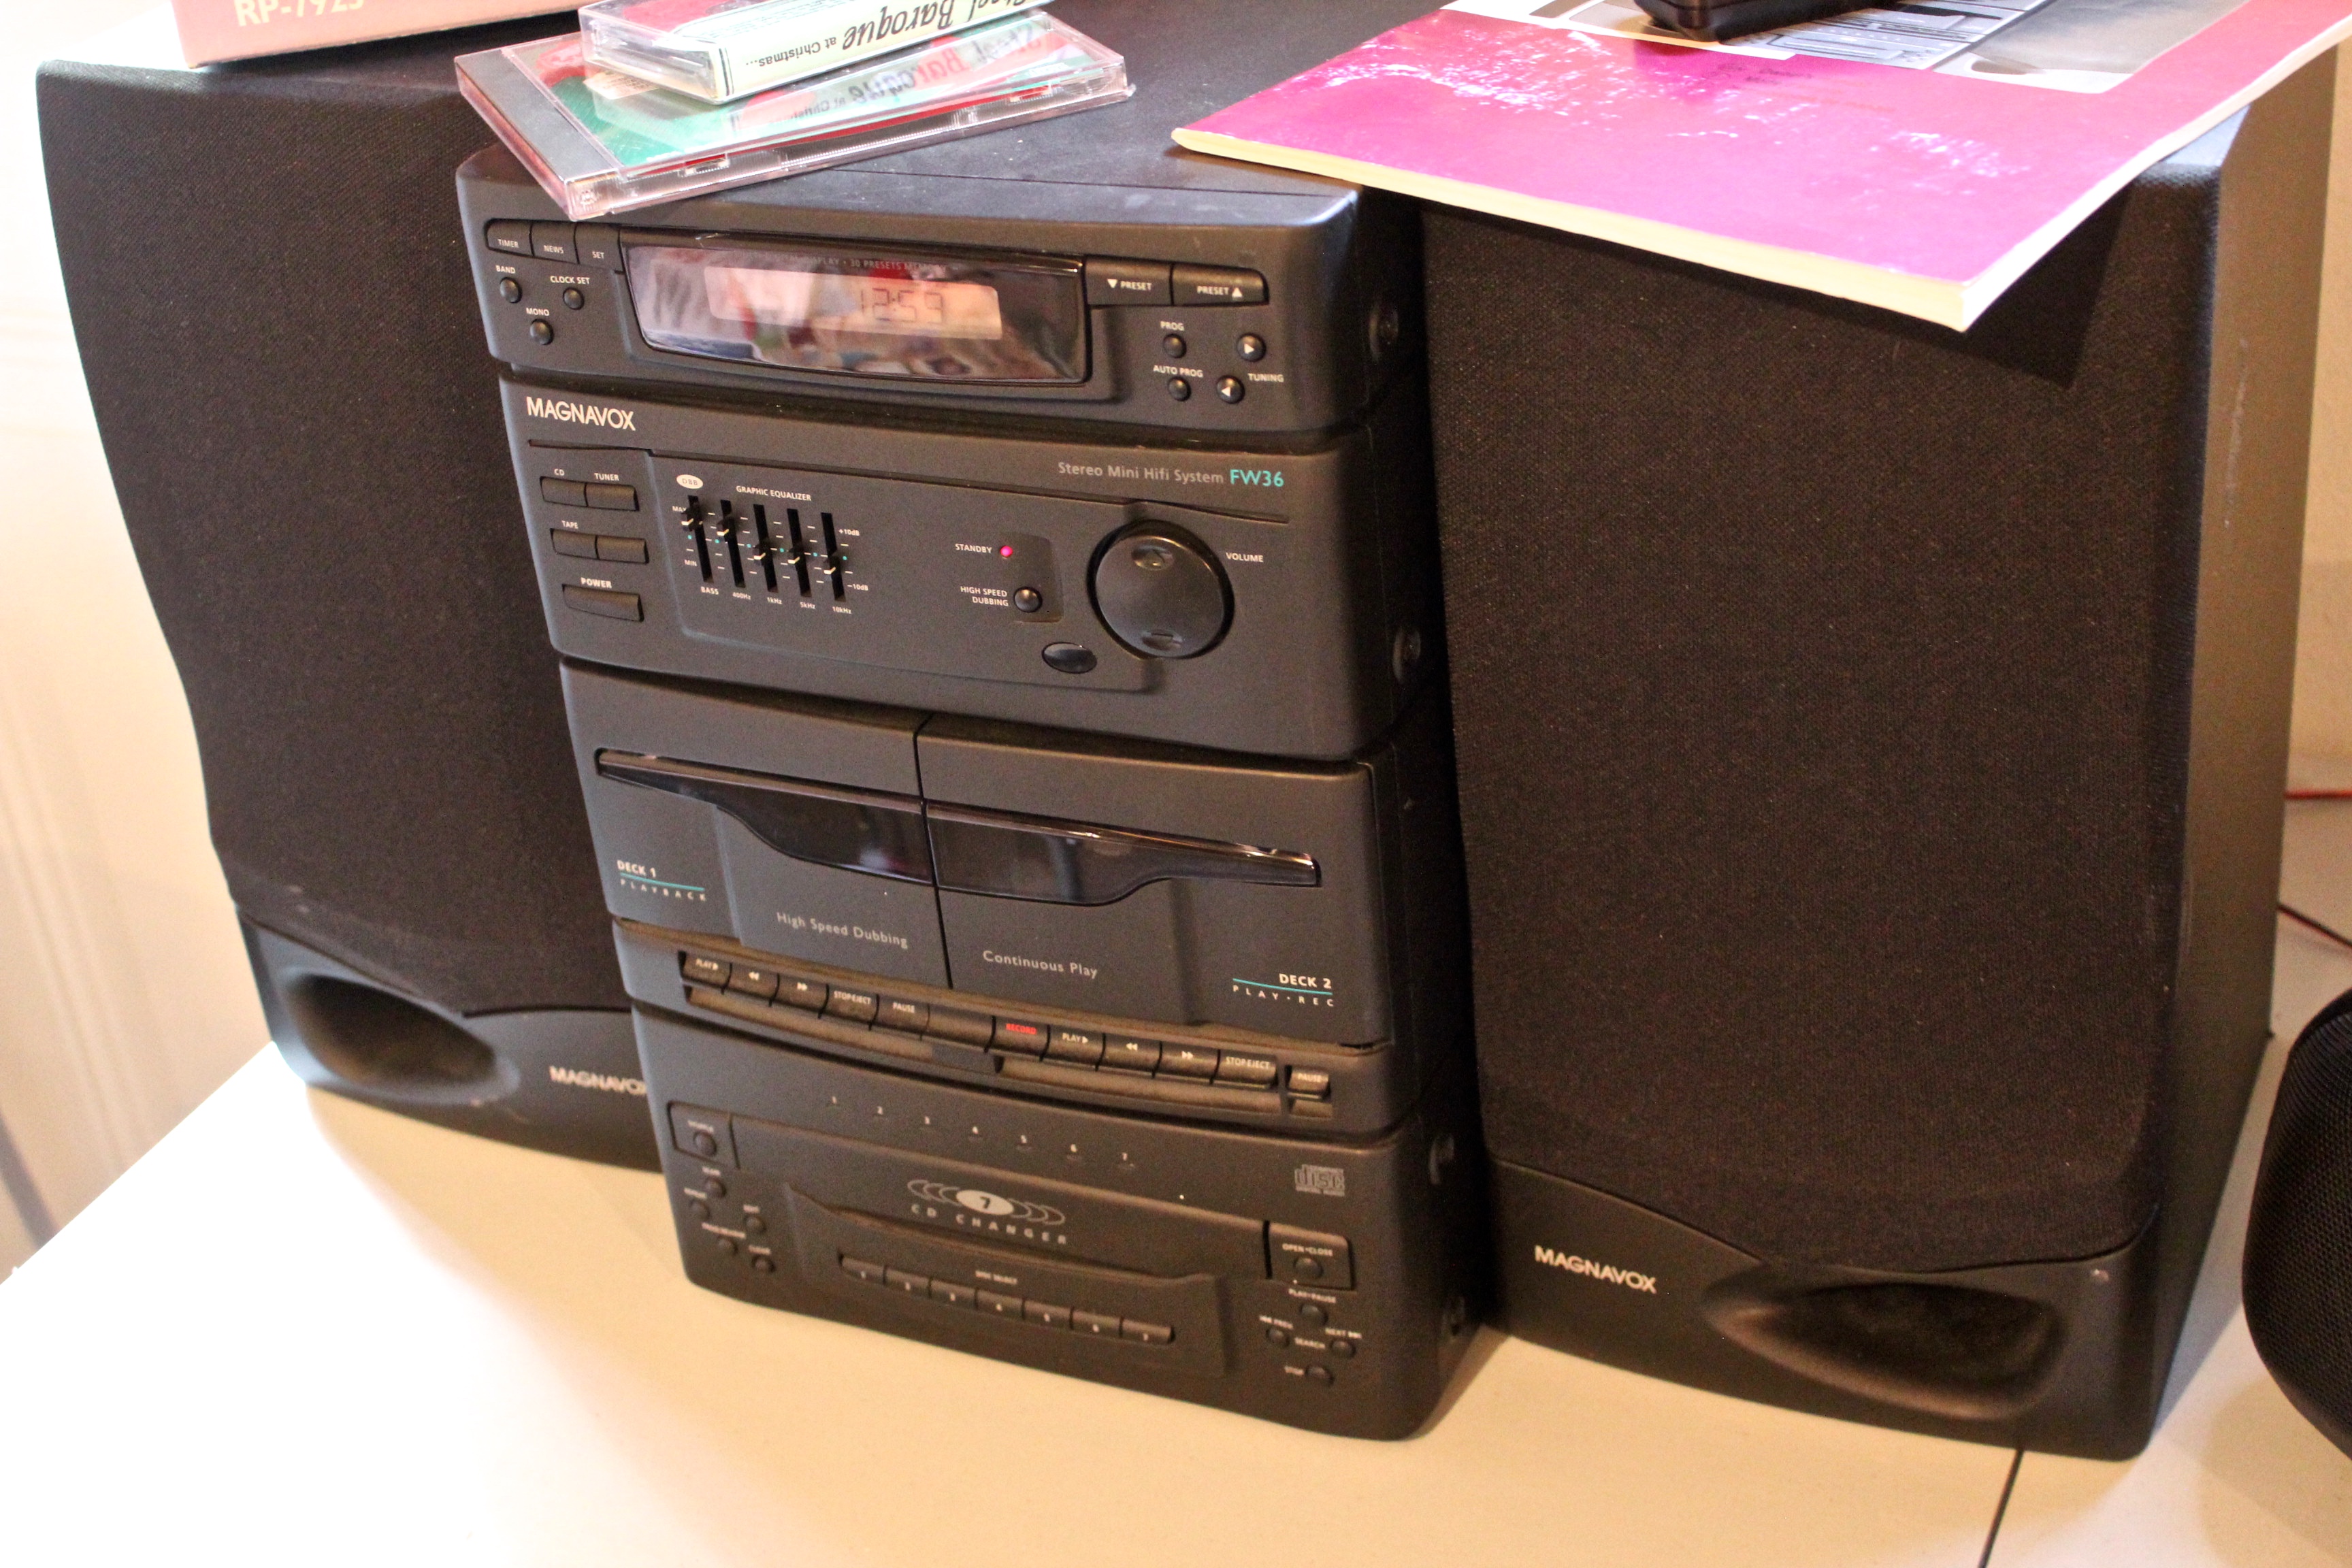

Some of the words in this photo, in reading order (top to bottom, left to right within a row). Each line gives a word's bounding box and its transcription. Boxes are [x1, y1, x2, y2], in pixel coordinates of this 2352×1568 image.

[843, 0, 953, 50] Baroque
[824, 37, 837, 49] at
[497, 239, 519, 248] TIMER
[544, 245, 564, 254] NEWS
[495, 265, 516, 274] BAND
[550, 276, 575, 284] CLOCK
[577, 276, 590, 284] SET
[1120, 280, 1152, 291] PRESET
[1197, 286, 1229, 295] PRESET
[860, 287, 947, 325] 12:59
[526, 308, 550, 316] MONO
[1160, 321, 1184, 331] PROG
[1153, 365, 1177, 375] AUTO
[1179, 367, 1203, 378] PROG
[1248, 373, 1284, 382] TUNING
[526, 396, 636, 431] MAGNAVOX
[594, 472, 619, 481] TUNER
[1058, 461, 1103, 476] Stereo
[1108, 466, 1139, 478] Mini
[1144, 467, 1170, 480] Hifi
[1174, 469, 1224, 485] System
[1229, 469, 1284, 487] FW36
[736, 485, 768, 496] GRAPHIC
[770, 489, 811, 501] EQUALIZER
[561, 520, 578, 529] TAPE
[955, 543, 992, 553] STANDBY
[1226, 552, 1264, 563] VOLUME
[581, 577, 612, 589] POWER
[701, 586, 719, 595] BASS
[732, 591, 751, 600] 400Hz
[960, 586, 981, 594] HIGH
[983, 588, 1007, 597] SPEED
[972, 596, 1009, 606] DUBBING
[832, 606, 852, 614] 10kHz
[617, 860, 646, 877] DECK
[650, 867, 657, 878] 1
[777, 912, 806, 929] High
[810, 918, 848, 936] Speed
[853, 926, 909, 949] Dubbing
[982, 950, 1064, 973] Continuous
[1069, 962, 1098, 979] Play
[1279, 973, 1318, 987] DECK
[1323, 978, 1332, 989] 2
[1006, 1023, 1037, 1034] RECORD
[1062, 1032, 1081, 1042] PLAY
[911, 1203, 937, 1218] CD
[956, 1213, 1066, 1245] CHANGER
[1535, 1245, 1657, 1294] MAGNAVOX
